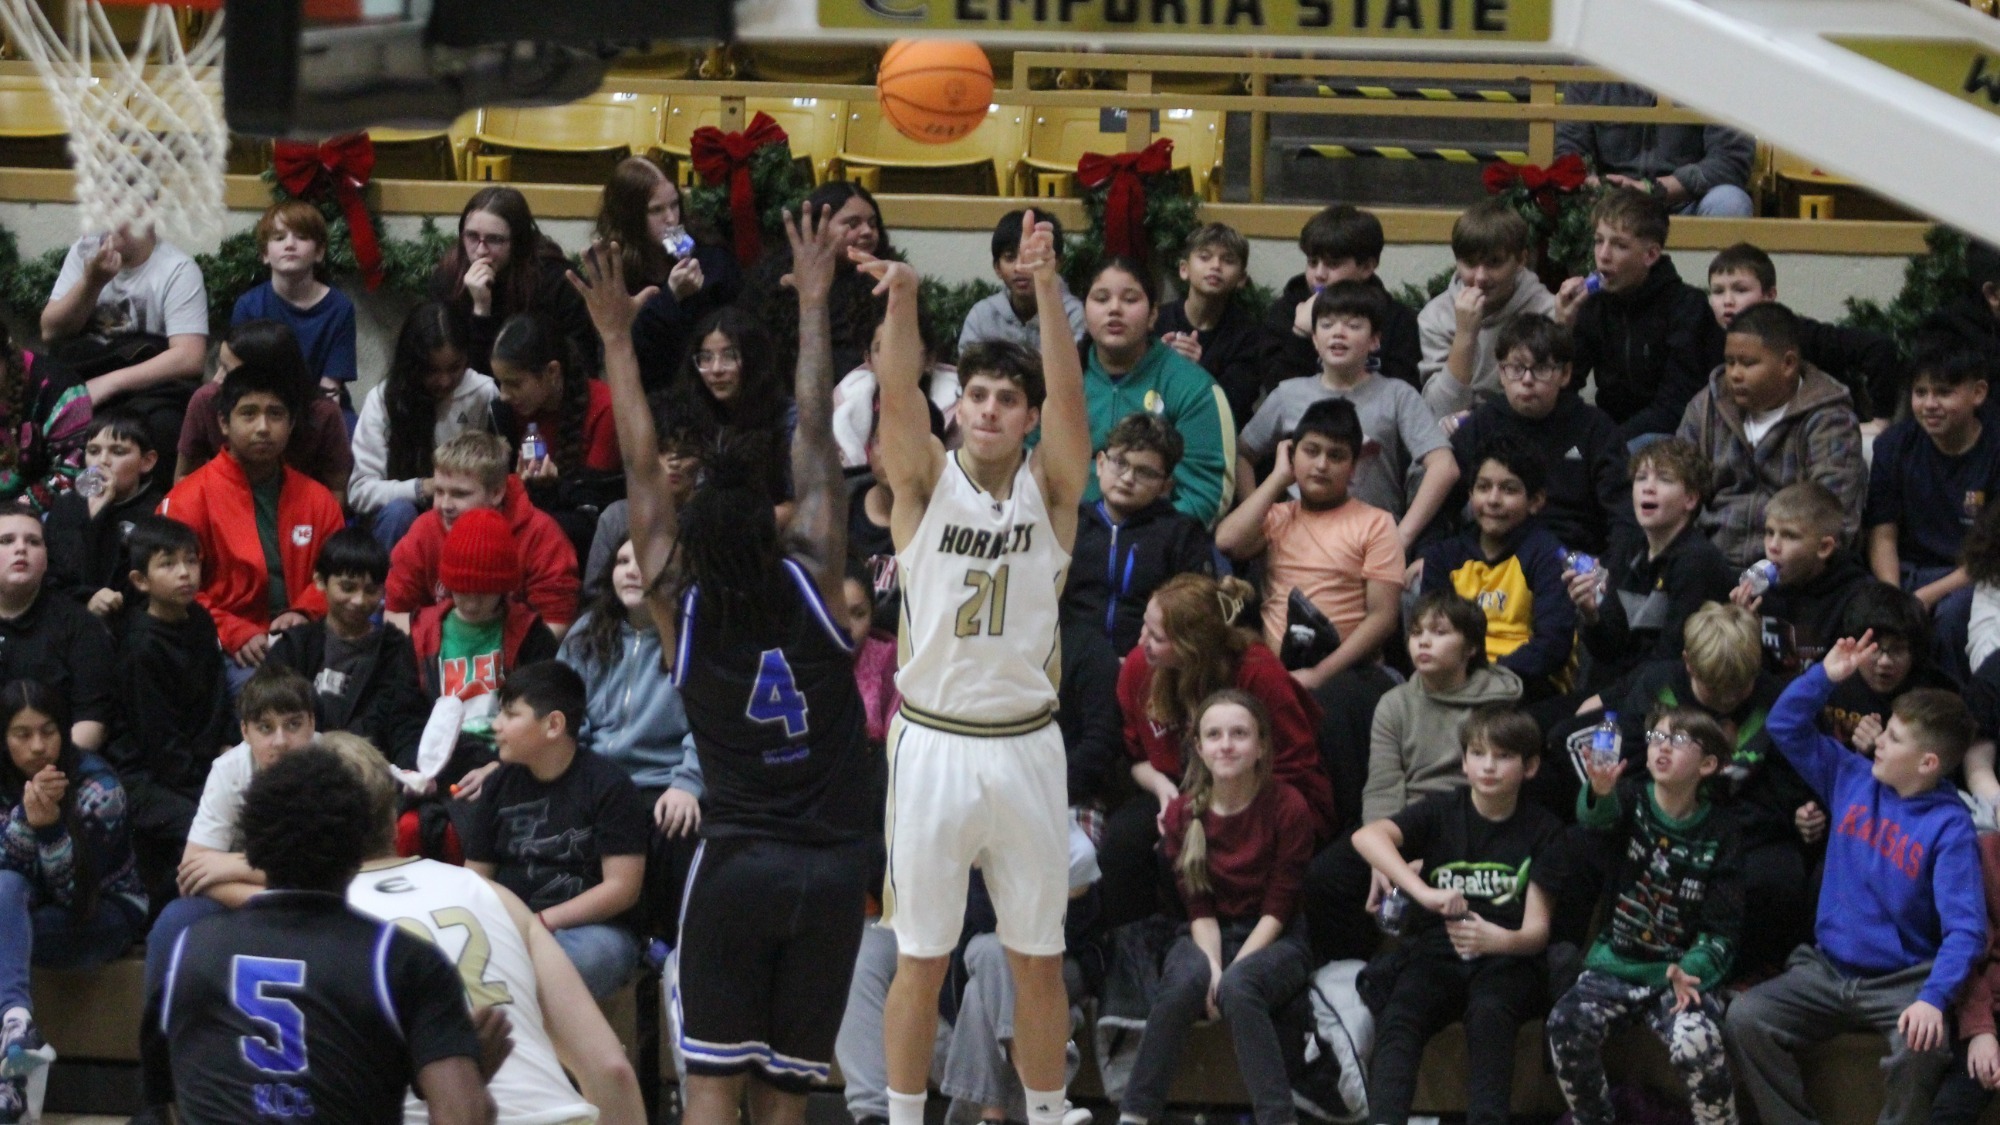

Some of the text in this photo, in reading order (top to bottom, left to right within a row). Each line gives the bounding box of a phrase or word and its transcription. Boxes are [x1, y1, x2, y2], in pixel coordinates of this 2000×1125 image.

[1297, 0, 1506, 31] STATE
[954, 563, 1010, 638] 21
[745, 646, 809, 738] 4
[1437, 867, 1520, 905] Reality
[388, 905, 514, 1008] 2
[231, 953, 309, 1075] 5
